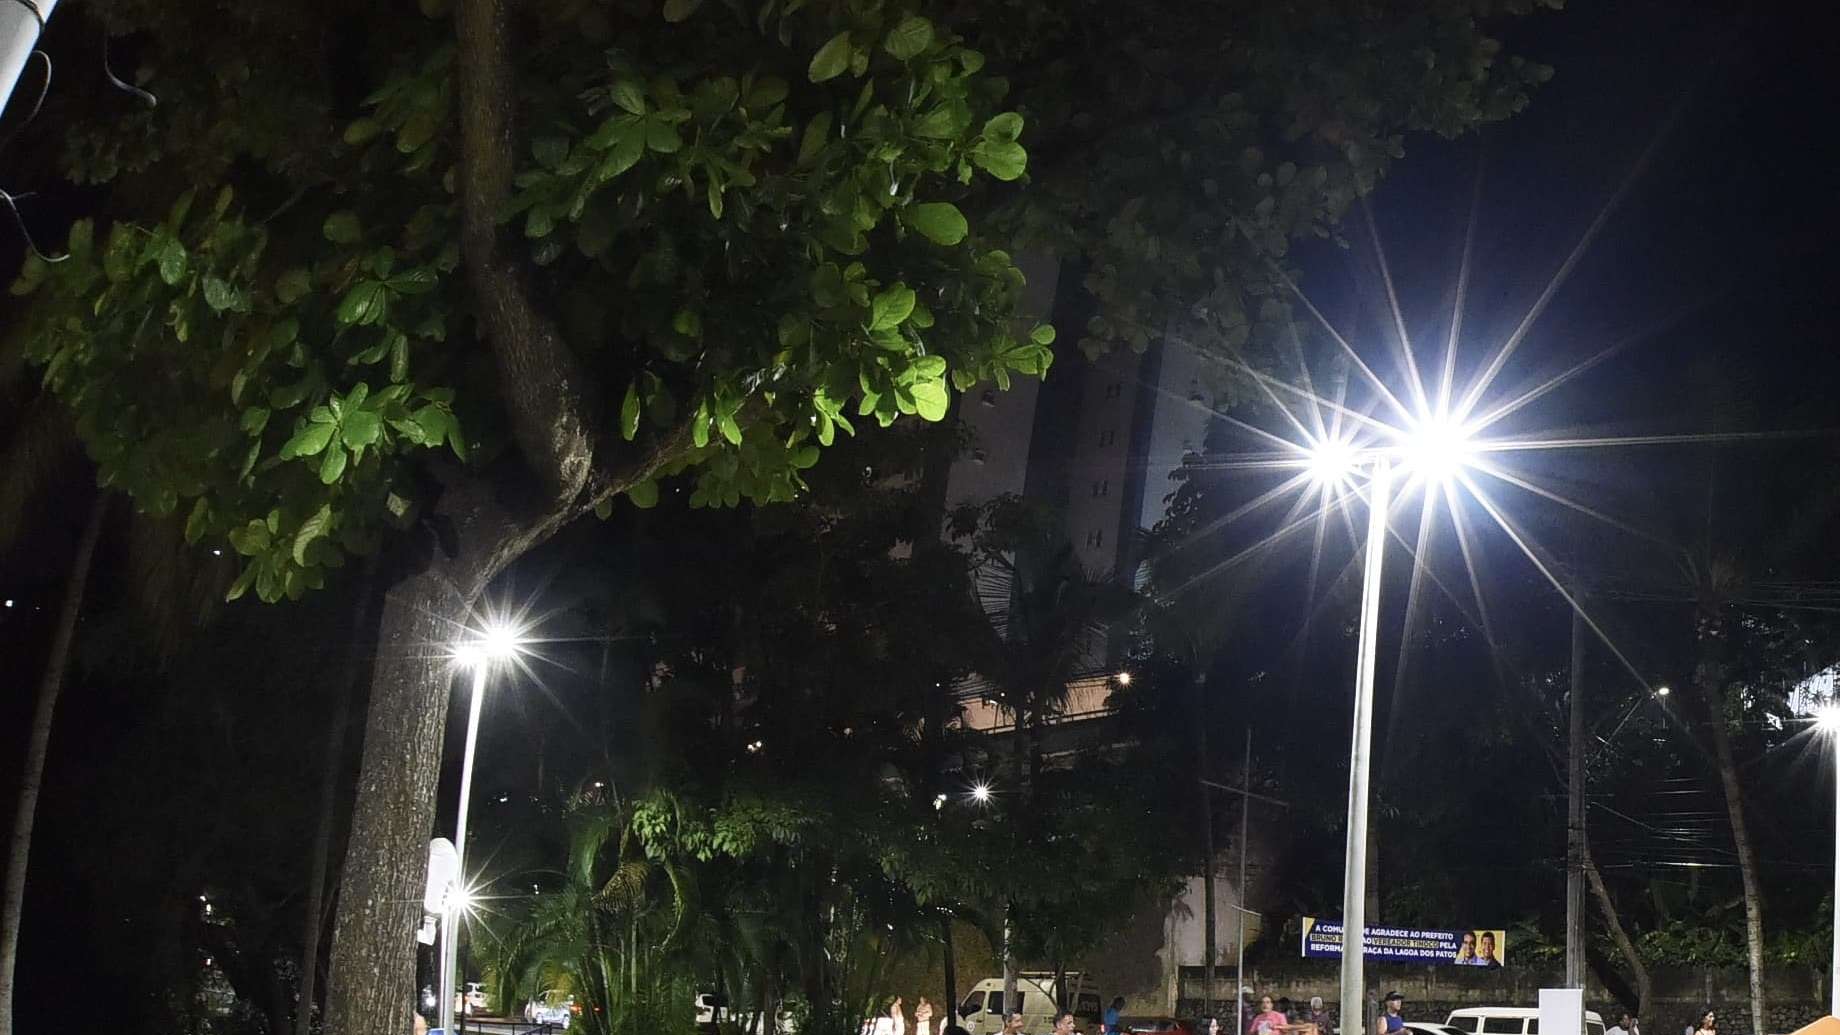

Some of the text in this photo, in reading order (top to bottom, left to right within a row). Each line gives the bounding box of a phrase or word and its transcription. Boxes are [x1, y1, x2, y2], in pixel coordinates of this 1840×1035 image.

[1371, 928, 1408, 937] AGRADECE
[1410, 930, 1420, 938] AO
[1421, 931, 1454, 940] PREFEITO
[1440, 941, 1457, 949] PELA
[1383, 947, 1393, 955] DA
[1395, 948, 1419, 956] LAGOA
[1420, 949, 1434, 957] DOS
[1435, 950, 1457, 959] PATOS
